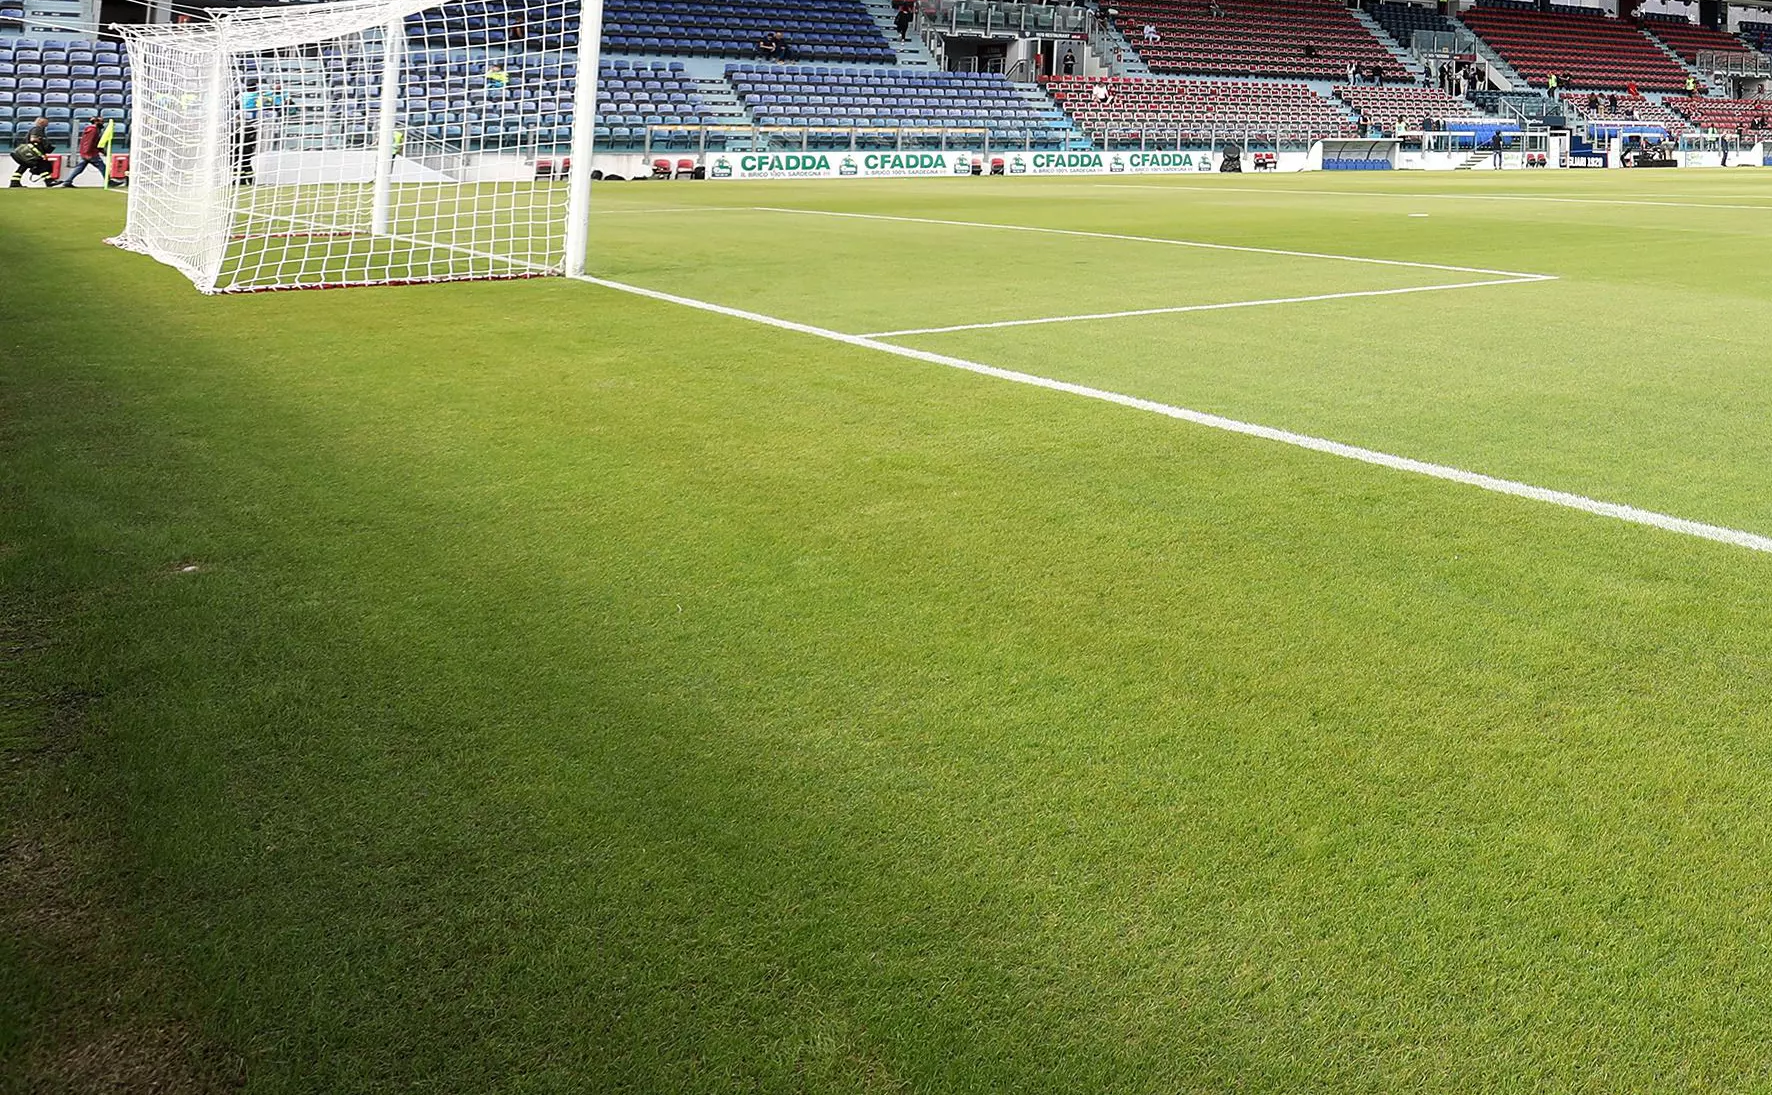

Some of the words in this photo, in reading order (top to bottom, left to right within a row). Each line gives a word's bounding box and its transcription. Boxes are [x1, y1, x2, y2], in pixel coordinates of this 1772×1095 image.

[741, 155, 831, 171] CFADDA
[864, 154, 947, 169] CFADDA
[1032, 154, 1103, 168] CFADDA
[1129, 153, 1193, 167] CFADDA
